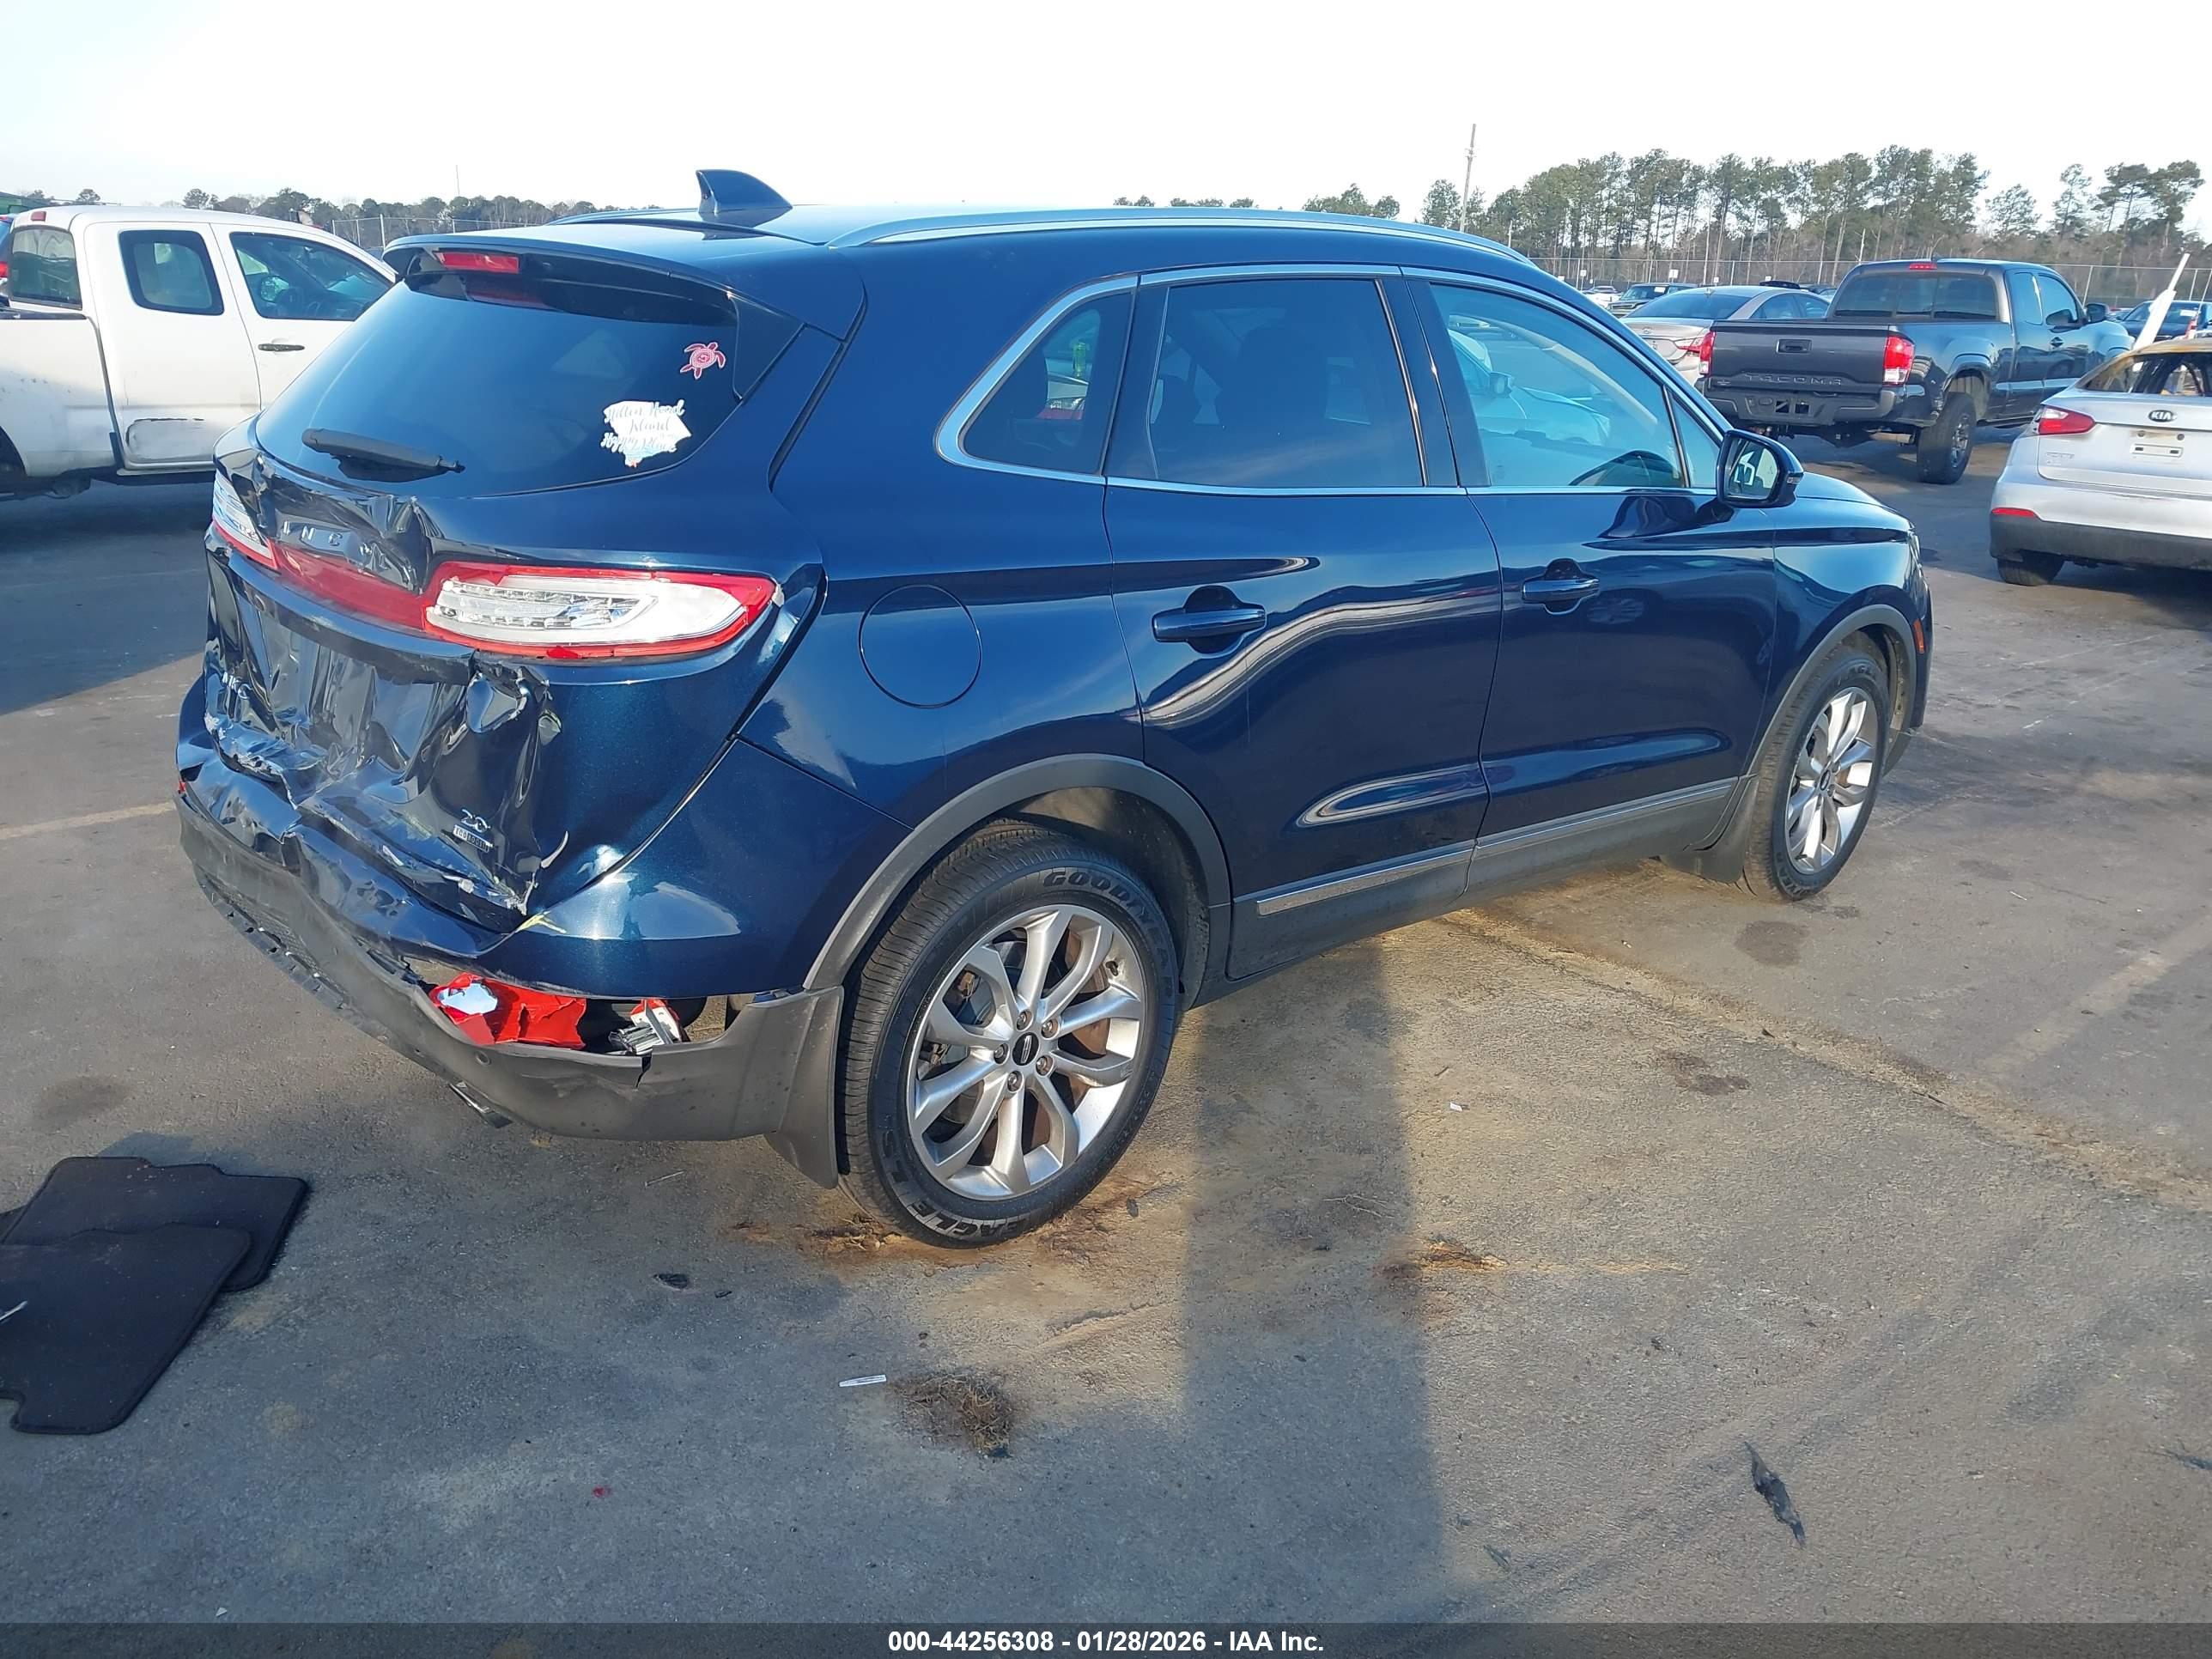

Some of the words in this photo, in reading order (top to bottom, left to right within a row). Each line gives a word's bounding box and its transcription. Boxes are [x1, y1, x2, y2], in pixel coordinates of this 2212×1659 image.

[1743, 372, 1842, 386] TACOMA
[2150, 411, 2173, 421] KIA
[910, 1201, 1031, 1237] EAGLE
